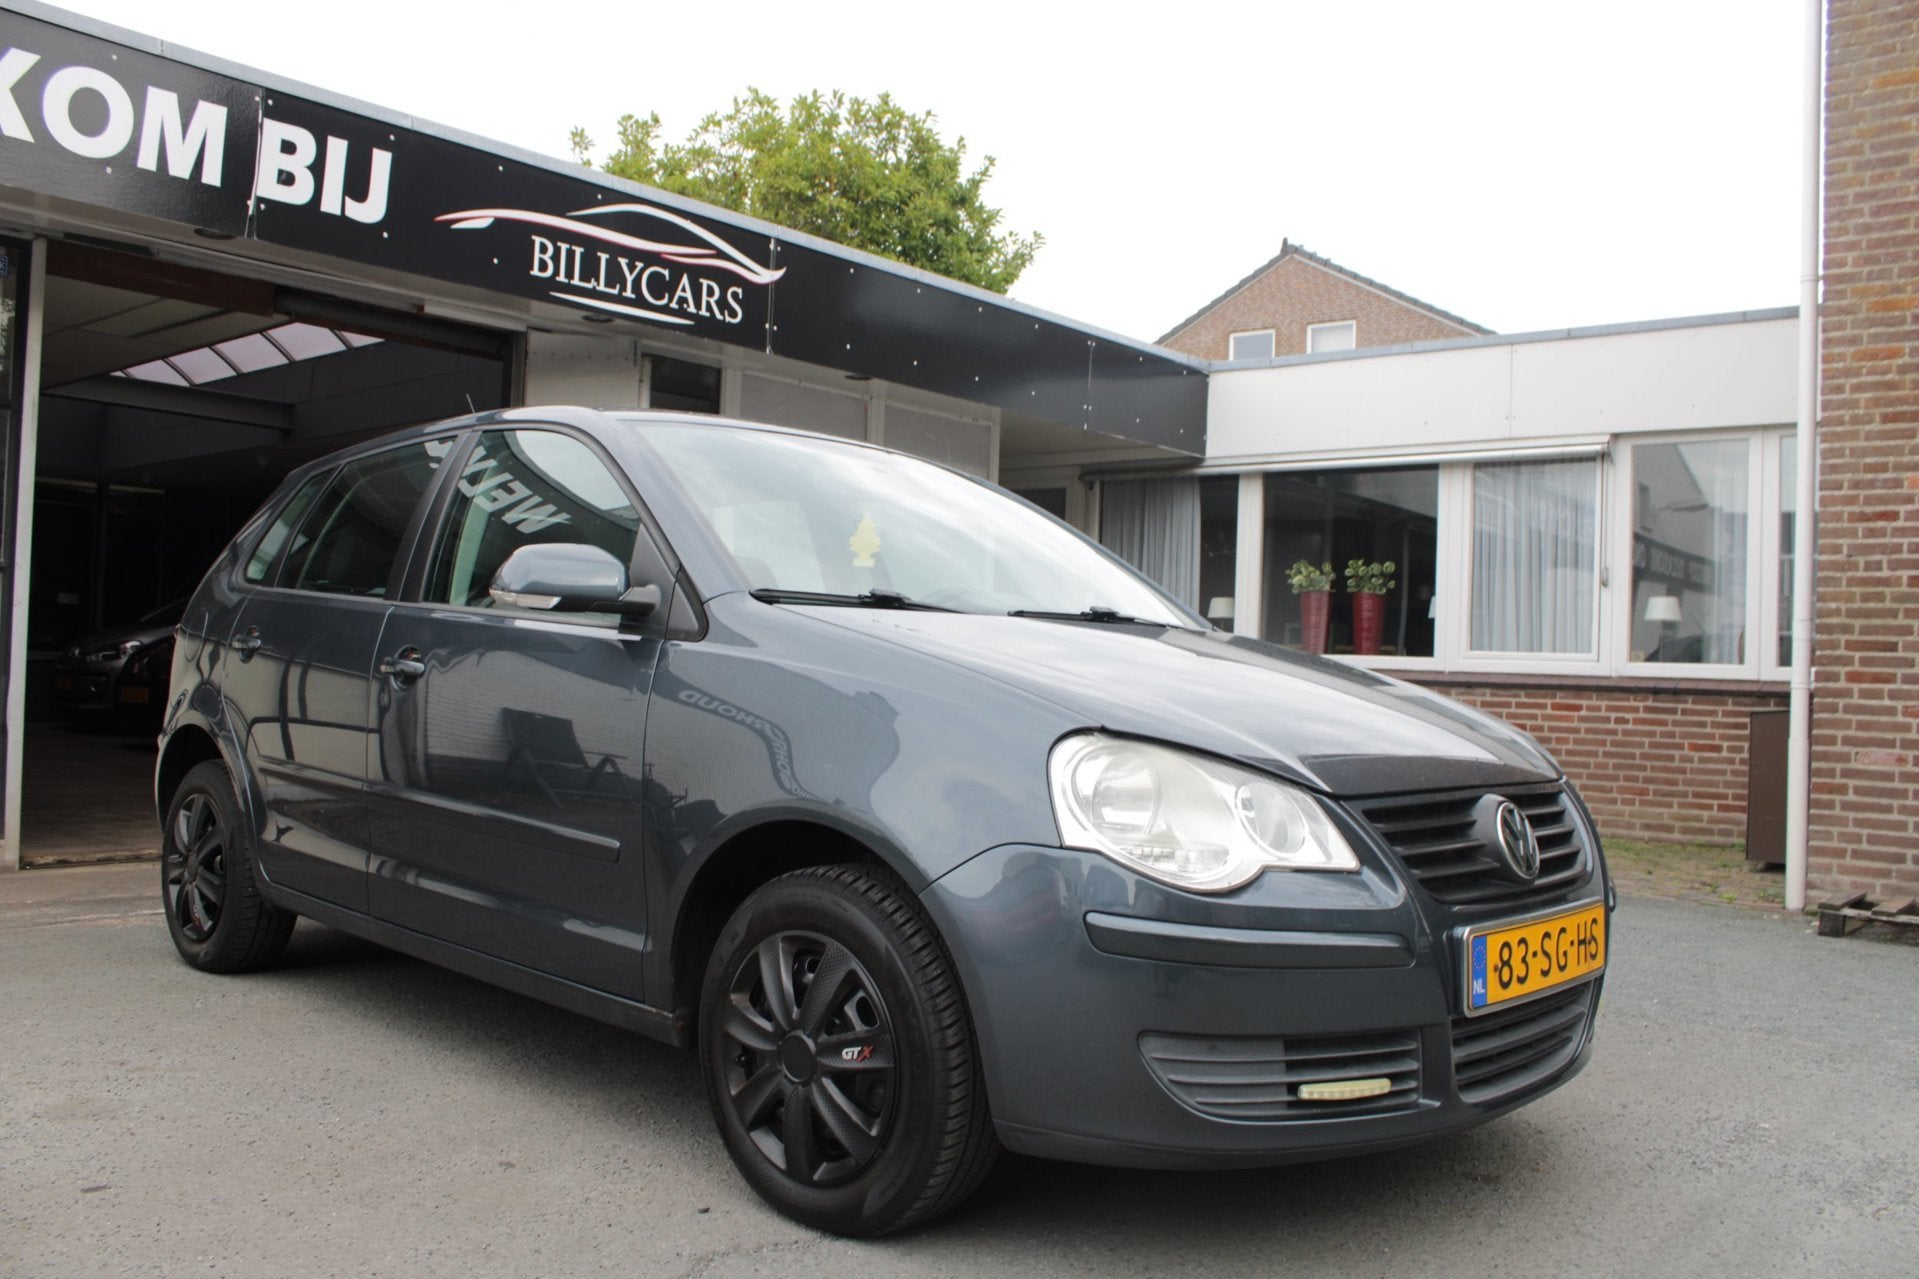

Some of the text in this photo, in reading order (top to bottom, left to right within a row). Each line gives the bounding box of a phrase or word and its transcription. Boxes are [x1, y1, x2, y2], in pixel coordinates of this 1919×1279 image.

[255, 117, 393, 225] BIJ
[530, 235, 743, 324] BILLYCARS
[1472, 978, 1486, 994] NL
[1499, 918, 1598, 989] 83-SG-HS
[842, 1046, 874, 1062] GTX
